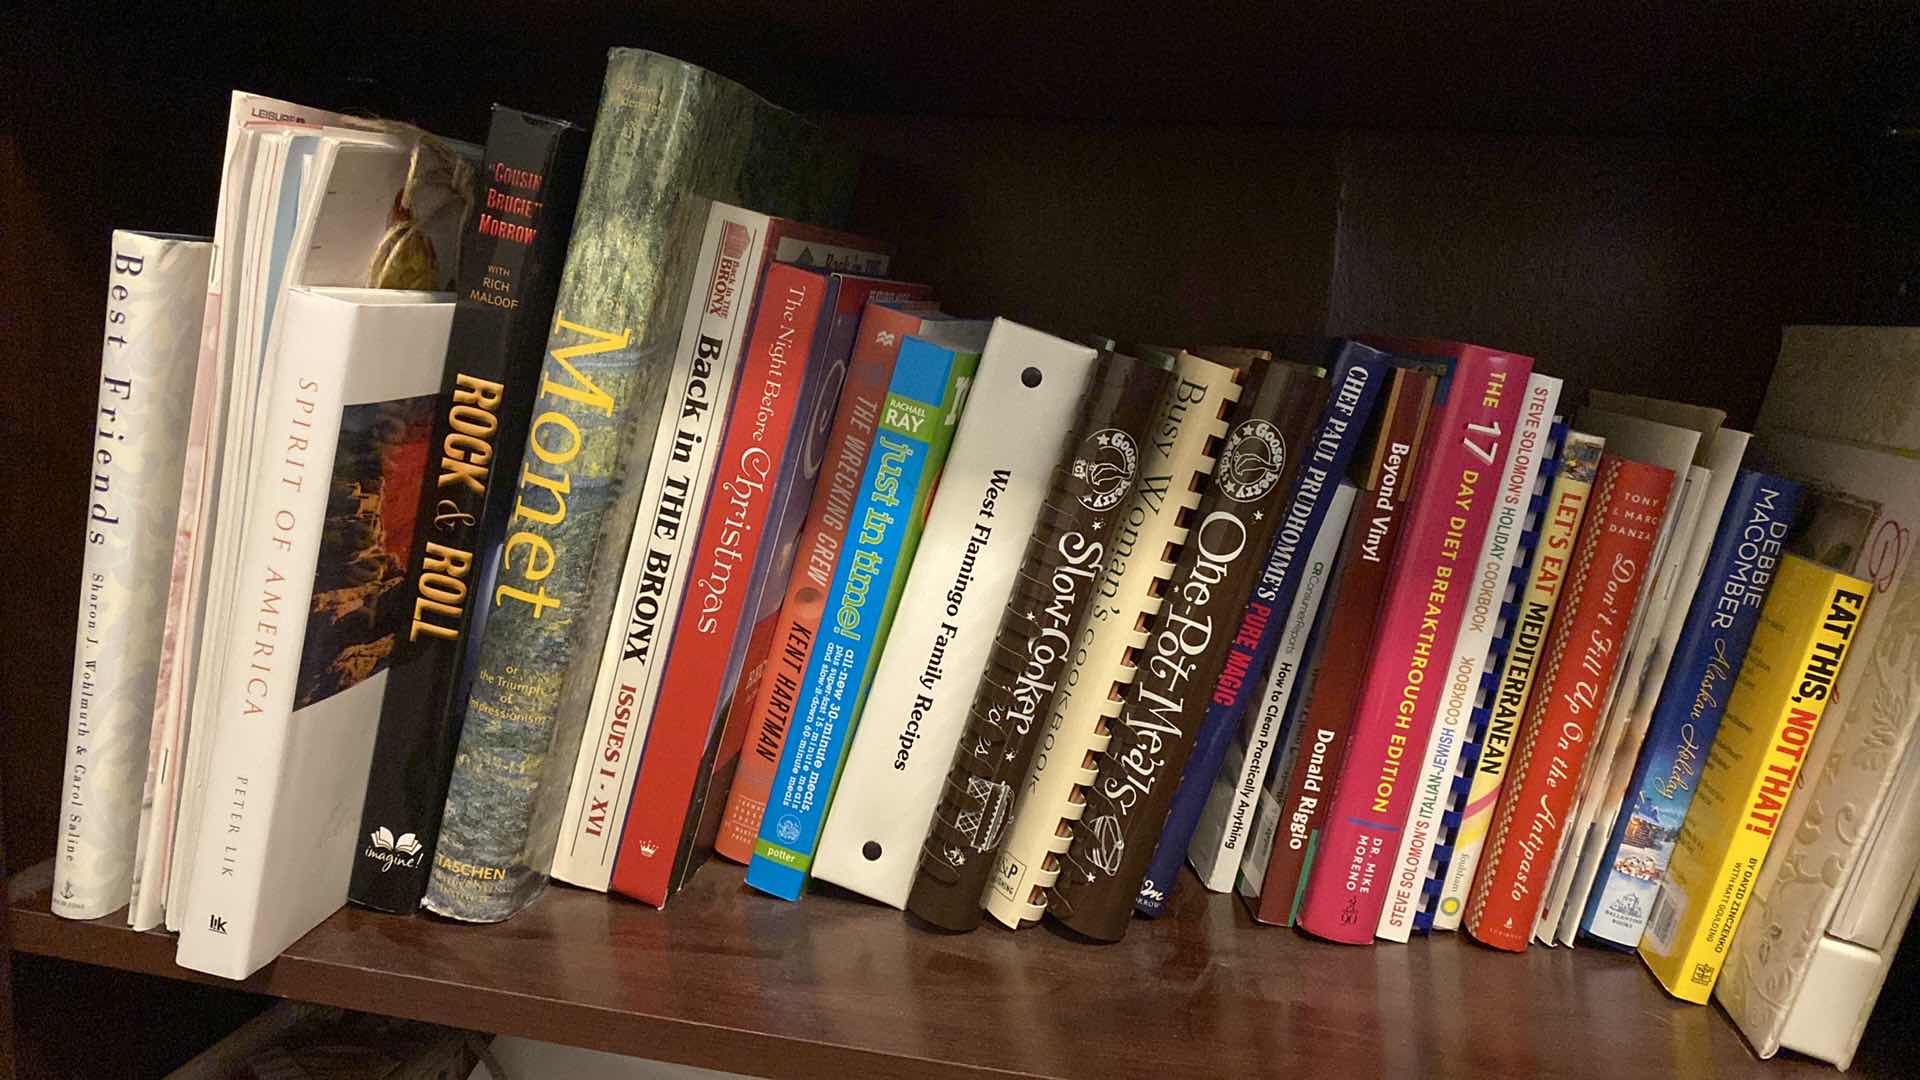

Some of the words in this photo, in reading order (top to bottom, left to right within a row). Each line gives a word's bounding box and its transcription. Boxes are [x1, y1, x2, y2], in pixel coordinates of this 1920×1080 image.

[479, 213, 538, 247] MORROW
[482, 276, 511, 293] RICH
[487, 263, 511, 277] WITH
[709, 257, 732, 318] BRONX
[107, 251, 144, 349] Best
[469, 289, 520, 311] MALOOF
[783, 285, 807, 323] The
[768, 324, 796, 378] Night
[681, 333, 723, 423] Back
[1335, 365, 1369, 418] CHEF
[1482, 372, 1507, 409] THE
[752, 380, 782, 442] Before
[849, 395, 879, 435] THE
[885, 407, 925, 433] RAY
[889, 399, 927, 417] RACHAEL
[1153, 378, 1209, 459] Busy
[1524, 386, 1549, 429] STEVE
[89, 374, 133, 546] Friends
[282, 377, 319, 492] SPIRIT
[437, 373, 504, 496] ROCK
[671, 429, 703, 464] in
[1255, 423, 1283, 464] Goose
[1312, 416, 1349, 463] PAUL
[1463, 421, 1502, 465] 17
[495, 309, 633, 619] Monet
[823, 433, 867, 531] WRECKING
[1376, 441, 1410, 511] Beyond
[1455, 468, 1480, 512] DAY
[1505, 430, 1537, 505] SOLOMON'S
[433, 499, 477, 532] &
[654, 474, 691, 542] THE
[979, 469, 1012, 519] West
[1547, 490, 1583, 550] LET'S
[1623, 510, 1658, 526] MARC
[1624, 491, 1659, 508] TONY
[272, 509, 296, 553] OF
[696, 447, 772, 635] Christmas
[859, 506, 895, 546] in
[1093, 474, 1174, 622] Woman's
[1256, 464, 1328, 602] PRUDHOMME'S
[1361, 515, 1392, 563] Vinyl
[1441, 515, 1466, 561] DIET
[1489, 504, 1517, 561] HOLIDAY
[1608, 522, 1651, 541] DANZA
[807, 531, 838, 587] CREW
[946, 522, 992, 617] Flamingo
[1535, 555, 1565, 596] EAT
[1711, 487, 1781, 631] MACOMBER
[1743, 521, 1788, 610] DEBBIE
[87, 572, 104, 630] Sharon
[409, 541, 473, 642] ROLL
[623, 548, 672, 667] BRONX
[833, 549, 883, 641] time!
[1150, 510, 1247, 693] One-Pot
[1469, 561, 1501, 633] COOKBOOK
[1597, 552, 1636, 626] Don't
[1822, 588, 1865, 643] EAT
[85, 636, 99, 649] J.
[243, 567, 286, 716] AMERICA
[782, 621, 812, 674] KENT
[824, 642, 835, 663] and
[1005, 531, 1104, 735] Slow-Cooker
[1234, 601, 1273, 651] PURE
[1394, 565, 1453, 730] BREAKTHROUGH
[505, 665, 518, 675] or
[832, 644, 844, 667] plus
[919, 621, 959, 691] Family
[1213, 650, 1254, 708] MAGIC
[1275, 661, 1293, 689] How
[1582, 629, 1613, 677] Fill
[1690, 637, 1731, 721] Alaskan
[1791, 641, 1846, 704] THIS,
[78, 659, 97, 737] Wohlmuth
[480, 669, 495, 684] the
[497, 675, 546, 697] Triumph
[500, 693, 513, 705] of
[1271, 690, 1284, 703] to
[1479, 600, 1549, 776] MEDITERRANEAN
[1563, 681, 1598, 715] Up
[603, 683, 637, 764] ISSUES
[755, 672, 797, 763] HARTMAN
[813, 703, 841, 768] 30-minute
[893, 693, 934, 771] Recipes
[1028, 628, 1095, 795] COOKBOOK
[1256, 704, 1280, 748] Clean
[1558, 722, 1584, 750] On
[1776, 707, 1818, 764] NOT
[76, 745, 87, 756] &
[792, 724, 812, 774] 60-minute
[802, 716, 825, 772] 15-minute
[1104, 681, 1184, 816] Meals
[1242, 740, 1269, 799] Practically
[1303, 728, 1336, 793] Donald
[1655, 723, 1700, 800] Holiday
[71, 764, 87, 807] Carol
[599, 767, 617, 779] I
[782, 776, 797, 807] meals
[792, 775, 807, 810] meals
[799, 771, 819, 814] meals,
[1371, 733, 1407, 813] EDITION
[1389, 884, 1412, 928] STEVE
[1402, 820, 1430, 890] SOLOMON'S
[1418, 727, 1456, 821] ITALIAN-JEWISH
[1444, 655, 1476, 727] COOKBOOK
[1546, 756, 1569, 788] the
[227, 775, 249, 834] PETER
[585, 795, 609, 838] XVI
[1224, 799, 1251, 850] Anything
[1289, 795, 1318, 851] Riggio
[1746, 763, 1799, 839] THAT!
[65, 813, 82, 863] Saline
[220, 845, 238, 878] LIK
[364, 845, 424, 873] imagine!
[767, 847, 796, 864] potter
[1346, 834, 1369, 892] MORENO
[1368, 837, 1384, 860] DR.
[1511, 794, 1557, 902] Antipasto
[1748, 857, 1759, 871] BY
[434, 852, 507, 881] TASCHEN
[1359, 862, 1377, 894] MIKE
[1727, 862, 1743, 884] WITH
[1735, 871, 1753, 901] DAVID
[1718, 884, 1735, 905] MATT
[1706, 904, 1727, 943] GOULDING
[1714, 900, 1741, 954] ZINCZENKO
